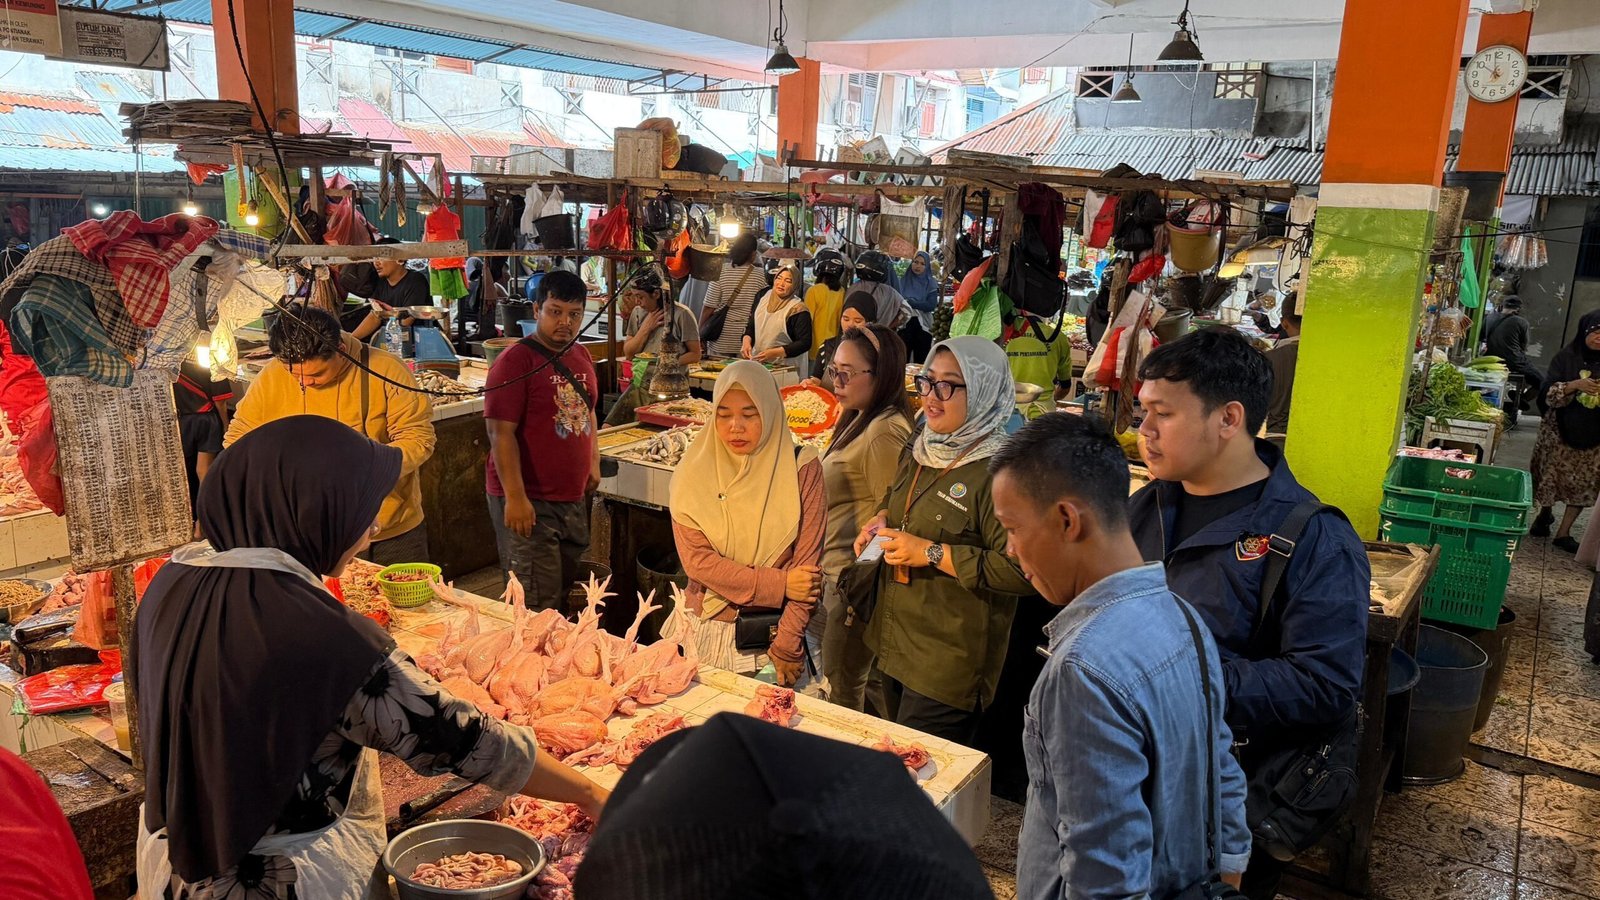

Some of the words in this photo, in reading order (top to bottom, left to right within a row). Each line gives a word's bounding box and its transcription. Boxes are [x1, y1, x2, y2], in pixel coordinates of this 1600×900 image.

[15, 20, 28, 28] OLEH
[76, 21, 100, 33] BUTUH
[101, 25, 121, 35] DANA
[1476, 61, 1485, 69] 10
[1512, 60, 1518, 68] 2
